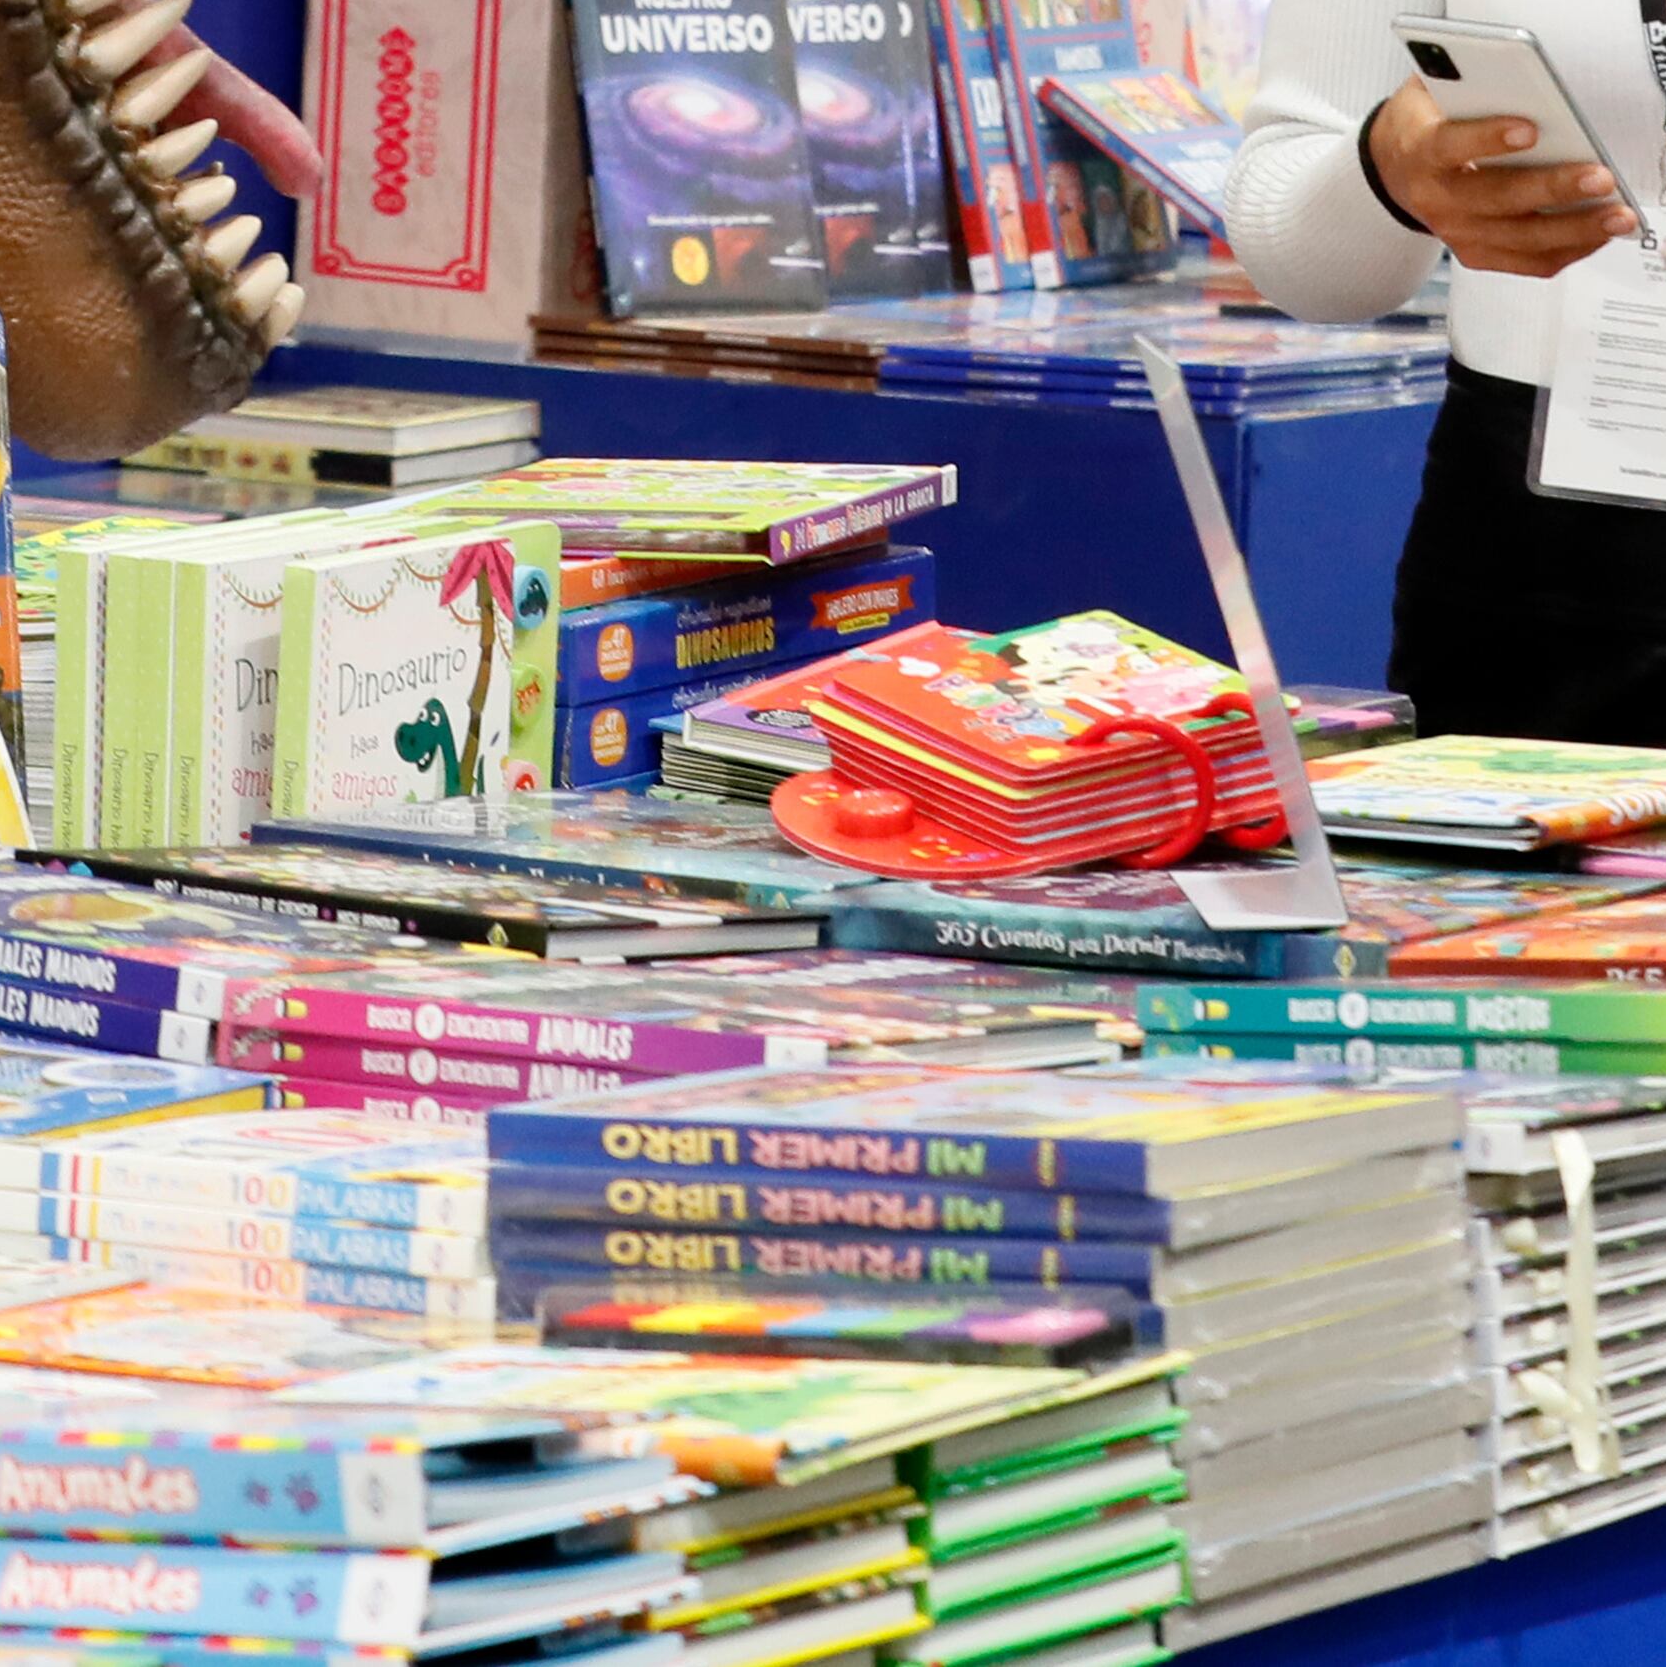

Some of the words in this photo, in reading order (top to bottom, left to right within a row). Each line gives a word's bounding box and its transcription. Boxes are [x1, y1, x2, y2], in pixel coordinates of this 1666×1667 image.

[600, 14, 775, 53] UNIVERSO
[786, 4, 885, 43] VERSO
[675, 616, 775, 670] DINOSAURIOS
[338, 646, 468, 717] Dinosaurio
[349, 734, 380, 760] hace
[332, 770, 398, 808] amigos
[935, 919, 977, 947] 365
[981, 924, 1066, 954] Cuentos
[1067, 936, 1103, 959] para
[1103, 933, 1171, 958] Dormir
[44, 946, 117, 994] MARINOS
[29, 988, 100, 1037] MARINOS
[1465, 995, 1551, 1033] INSECTOS
[536, 1016, 633, 1060] ANIMALES
[528, 1061, 623, 1099] ANIMALES
[601, 1123, 740, 1166] LIBRO
[747, 1128, 920, 1174] PRIMER
[927, 1138, 987, 1176] MI
[230, 1170, 289, 1210] 100
[297, 1173, 414, 1218] PALABRAS
[605, 1178, 747, 1223] LIBRO
[758, 1184, 934, 1231] PRIMER
[942, 1195, 1004, 1232] MI
[226, 1216, 286, 1254] 100
[293, 1222, 410, 1271] PALABRAS
[604, 1230, 741, 1273] LIBRO
[751, 1236, 925, 1282] PRIMER
[240, 1258, 301, 1298] 100
[305, 1264, 425, 1311] PALABRAS
[929, 1248, 991, 1284] MI
